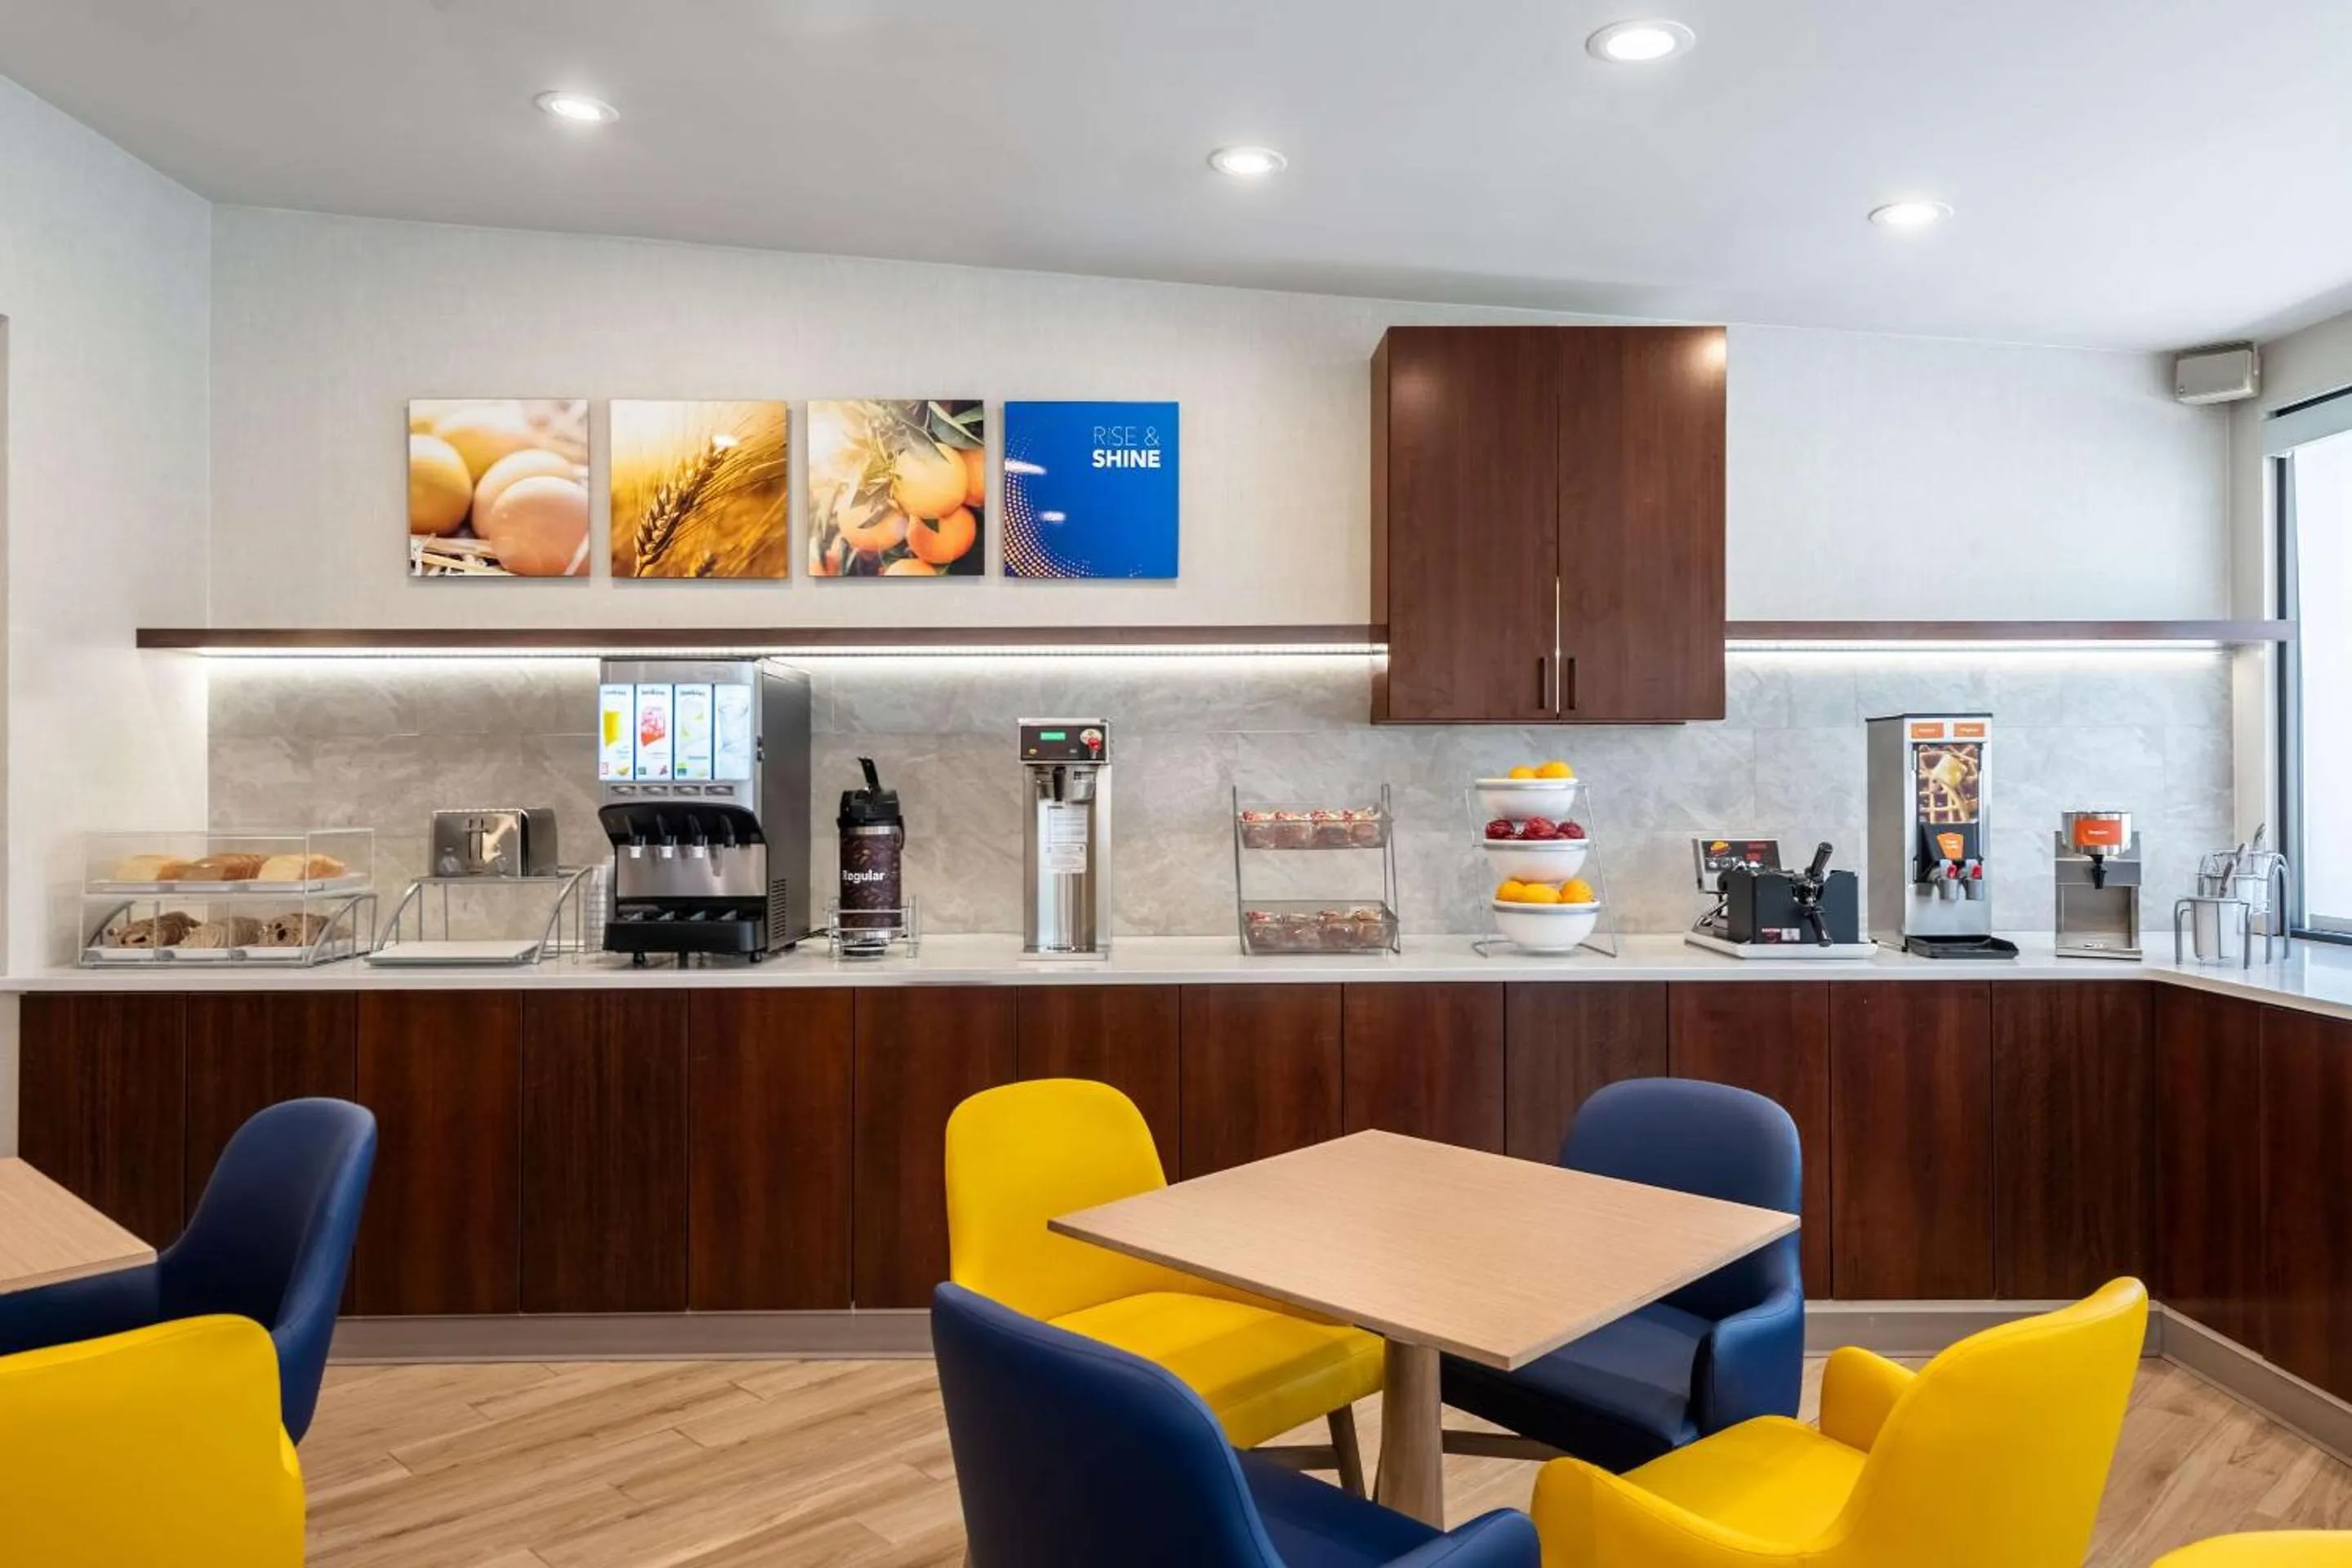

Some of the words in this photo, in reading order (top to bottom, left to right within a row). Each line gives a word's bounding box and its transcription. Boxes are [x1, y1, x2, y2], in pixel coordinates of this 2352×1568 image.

[1094, 425, 1138, 446] RISE
[1143, 425, 1160, 447] &
[1092, 449, 1161, 468] SHINE
